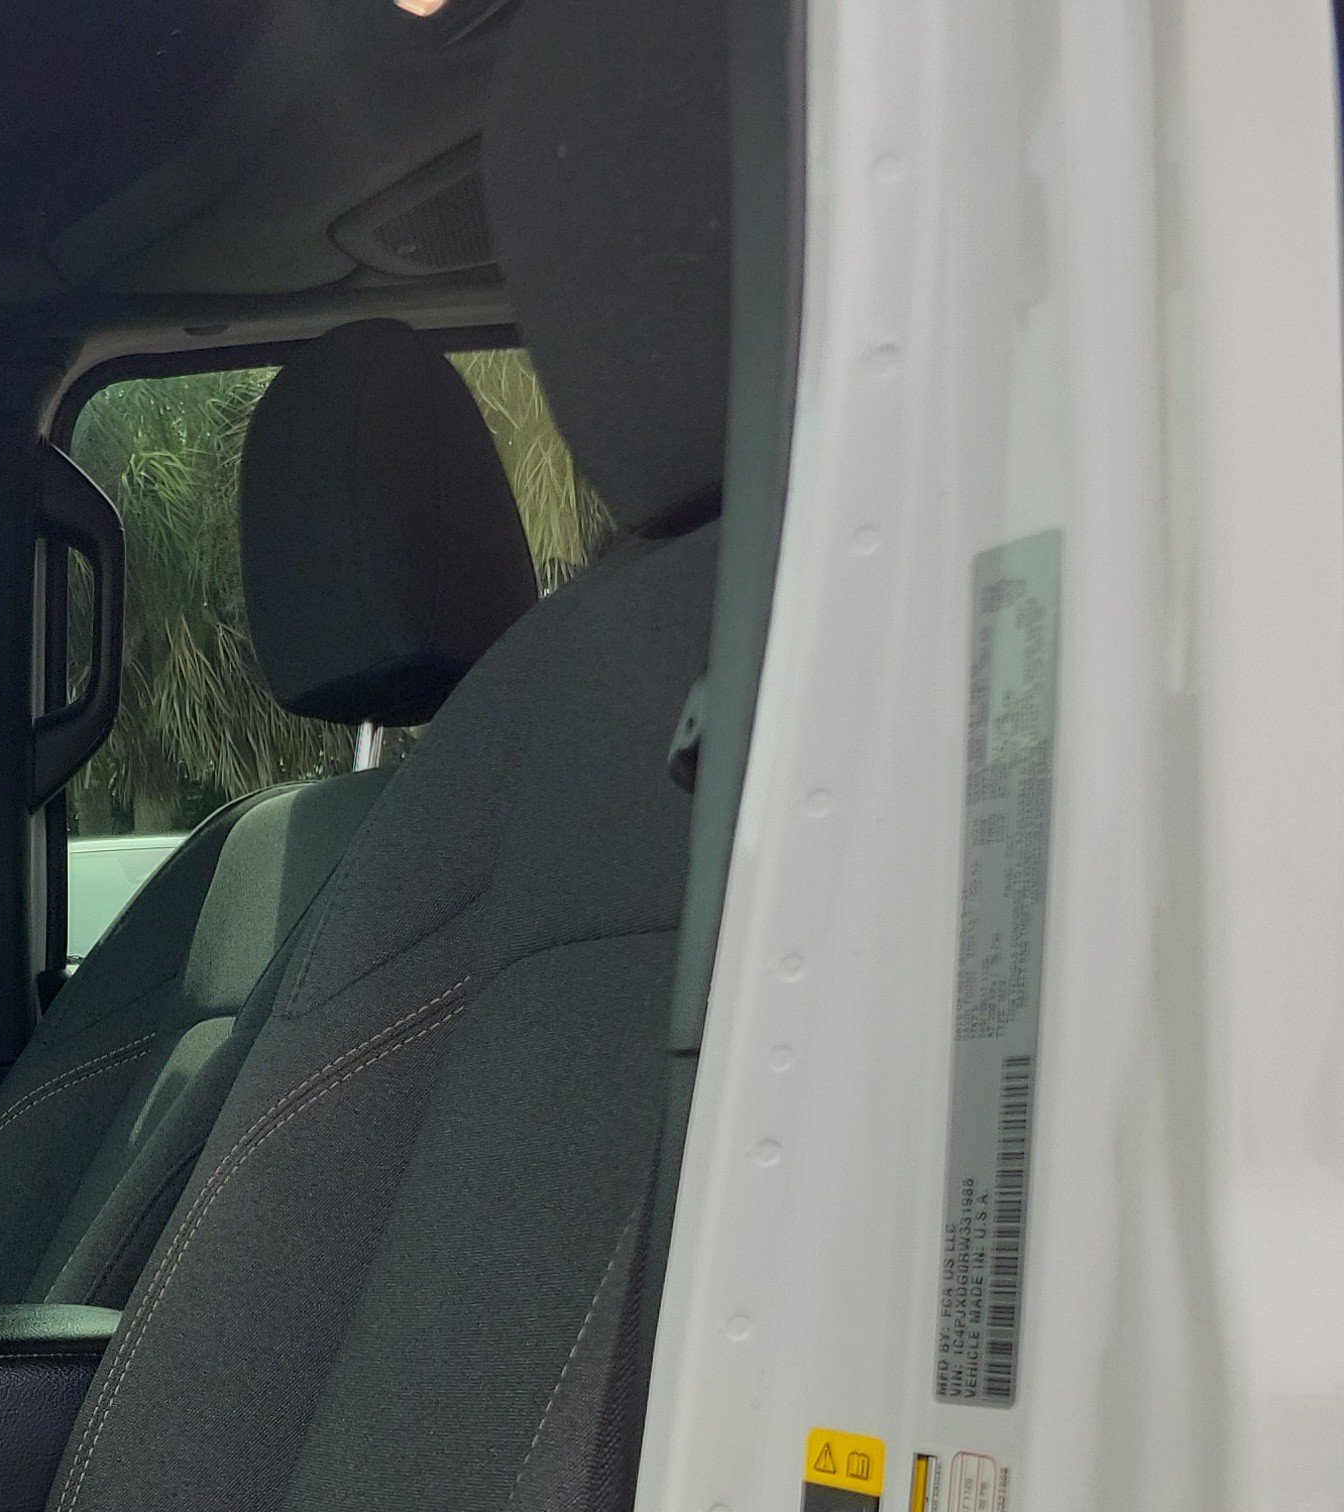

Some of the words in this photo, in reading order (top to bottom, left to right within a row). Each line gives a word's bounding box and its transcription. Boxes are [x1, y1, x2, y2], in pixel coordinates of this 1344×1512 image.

[945, 1223, 956, 1252] LLC
[943, 1259, 955, 1281] US
[941, 1288, 953, 1318] FCA
[969, 1275, 984, 1324] MADE
[936, 1361, 950, 1396] MFD
[950, 1364, 963, 1397] VIN:
[964, 1331, 980, 1399] VEHICLE
